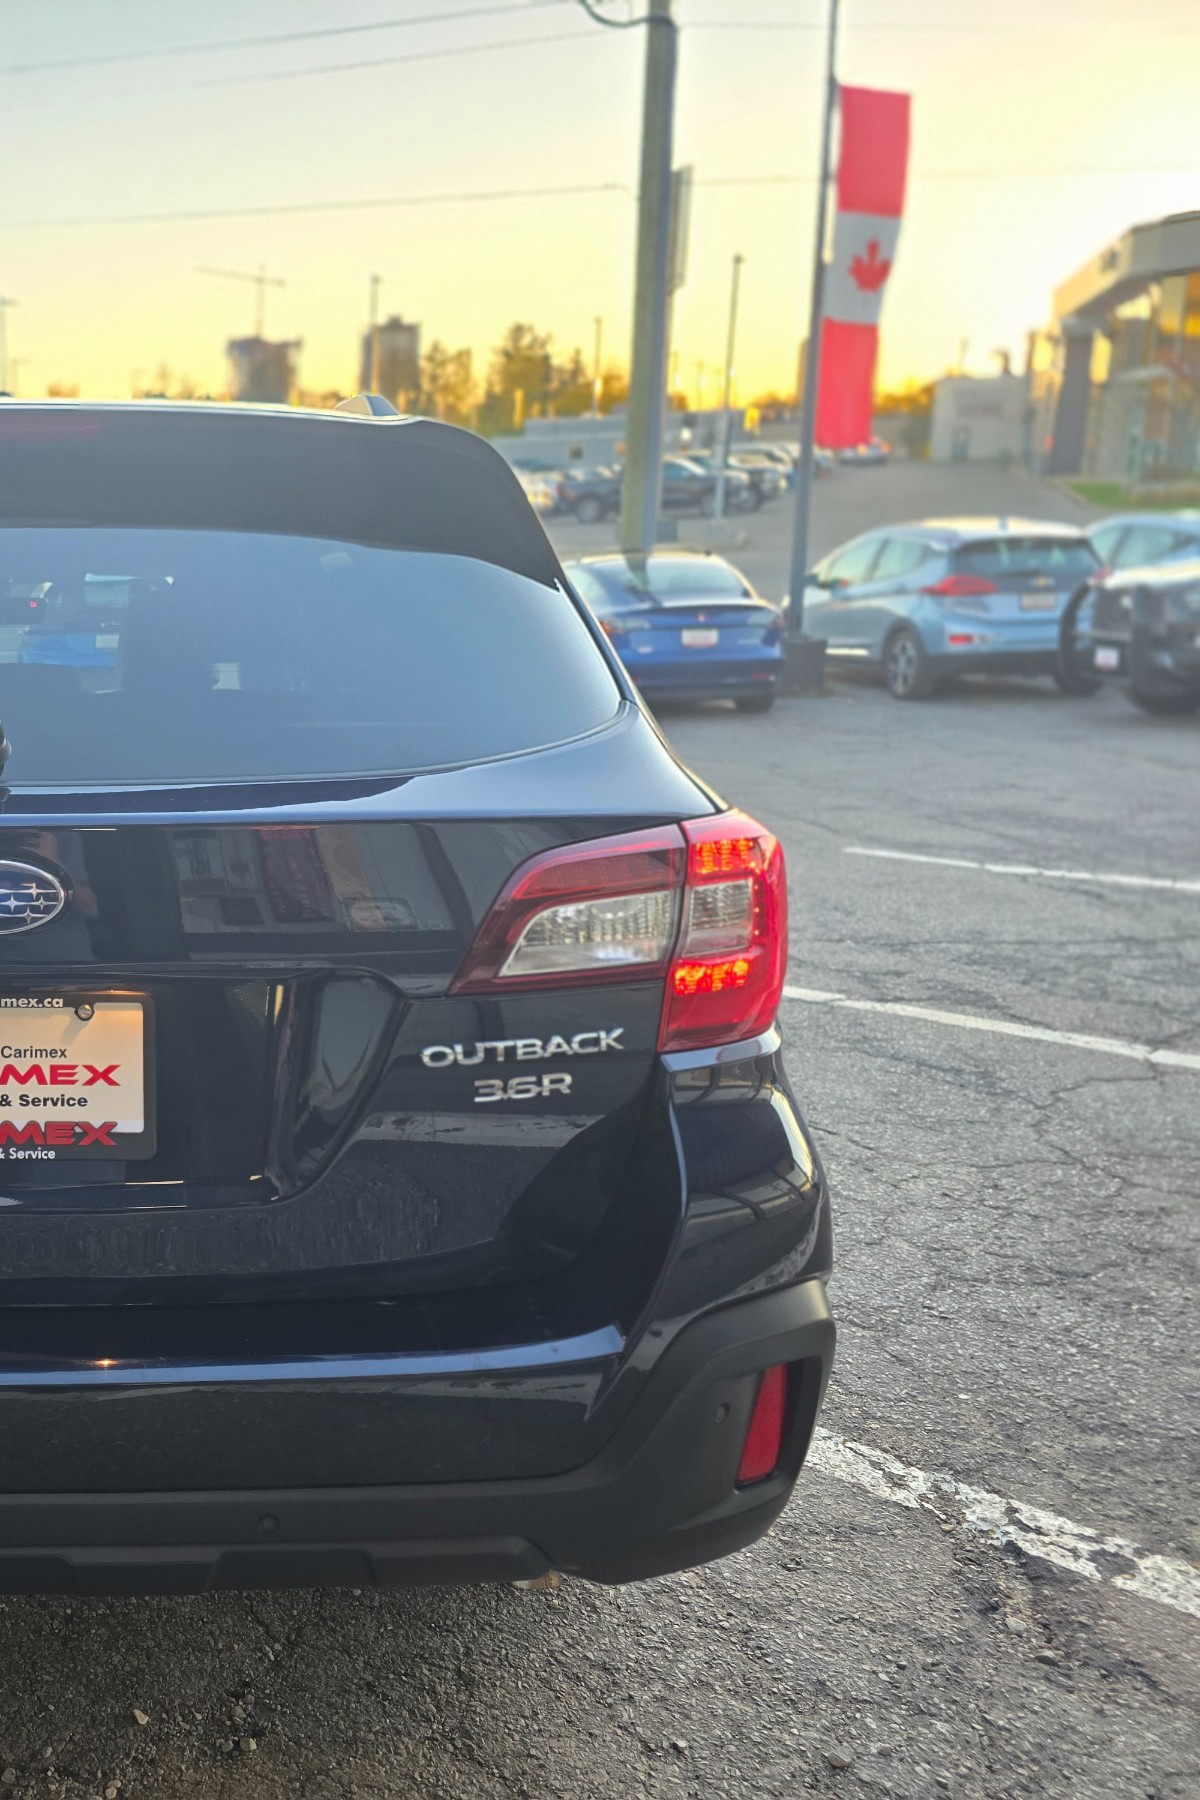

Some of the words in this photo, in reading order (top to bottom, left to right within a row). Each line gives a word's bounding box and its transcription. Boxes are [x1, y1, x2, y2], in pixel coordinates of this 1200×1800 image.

[0, 1046, 67, 1059] Carimex
[421, 1028, 624, 1067] OUTBACK
[0, 1094, 12, 1107] &
[18, 1094, 88, 1107] Service
[9, 1148, 56, 1160] Service
